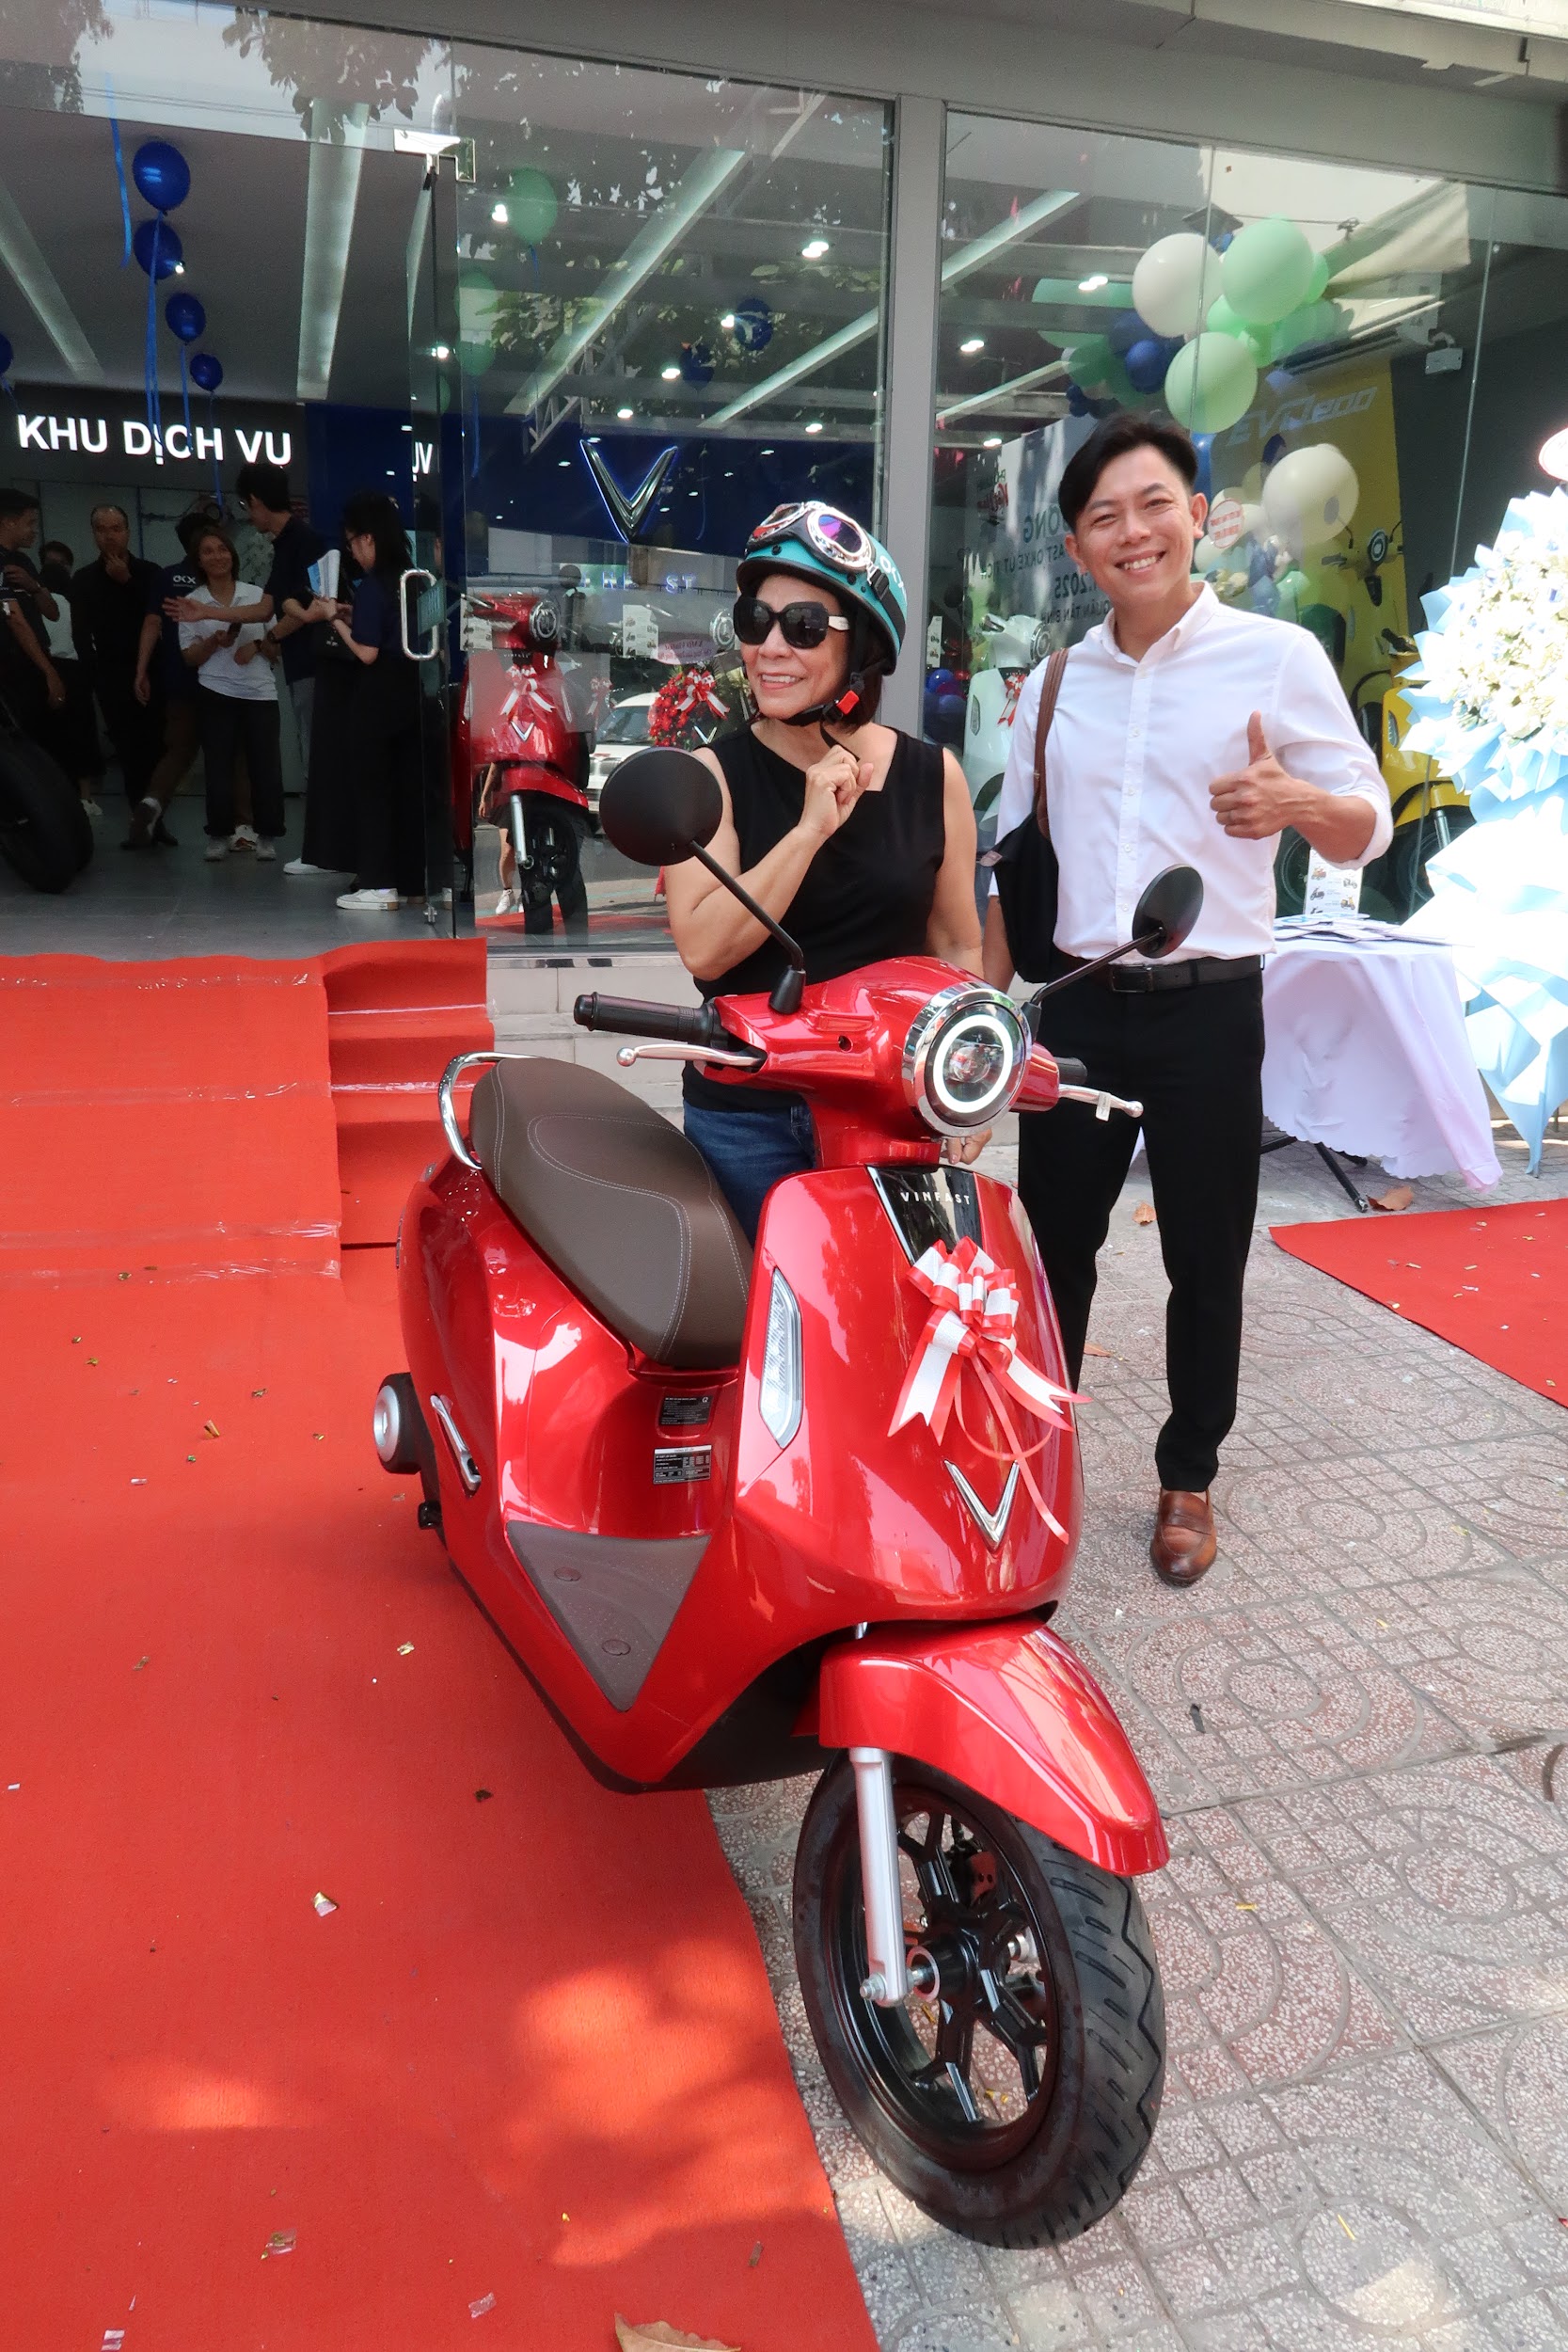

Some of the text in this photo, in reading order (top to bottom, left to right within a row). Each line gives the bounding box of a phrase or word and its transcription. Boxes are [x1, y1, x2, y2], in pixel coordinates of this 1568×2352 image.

[17, 413, 109, 453] KHU
[122, 420, 225, 466] DỊCH
[900, 1191, 971, 1205] VINFAST
